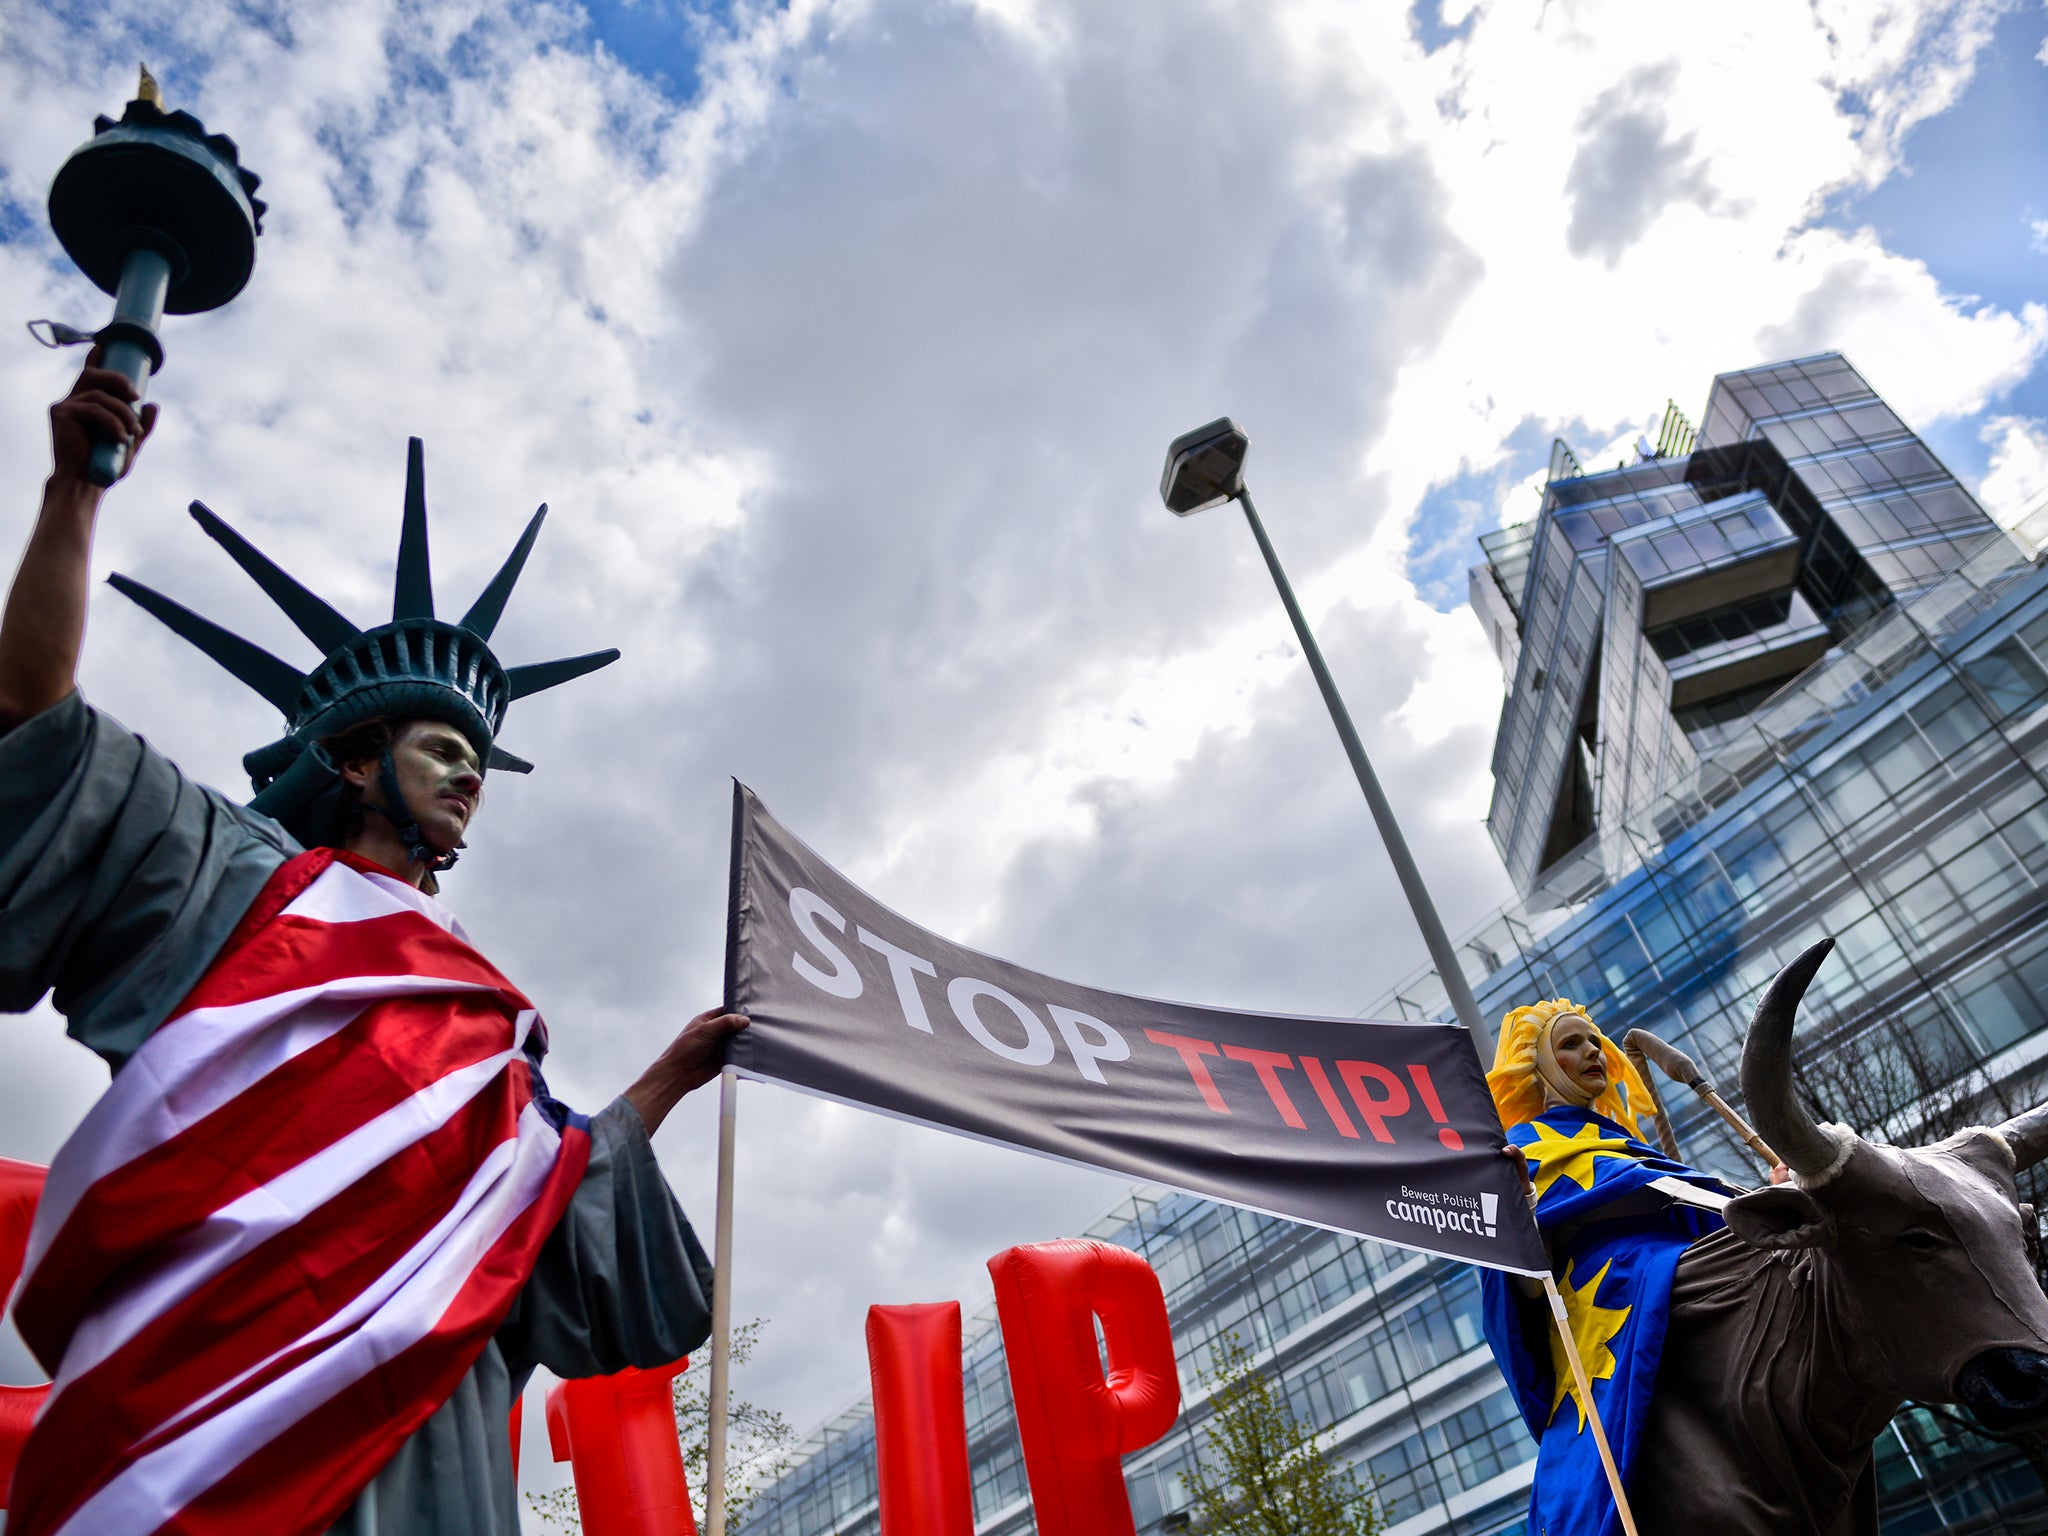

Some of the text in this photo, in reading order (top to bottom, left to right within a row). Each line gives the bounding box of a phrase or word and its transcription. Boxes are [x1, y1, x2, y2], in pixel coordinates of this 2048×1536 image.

[788, 887, 1465, 1152] STOP TTIP!
[1386, 1192, 1499, 1238] campact!
[1401, 1185, 1480, 1210] Bewegt Politik
